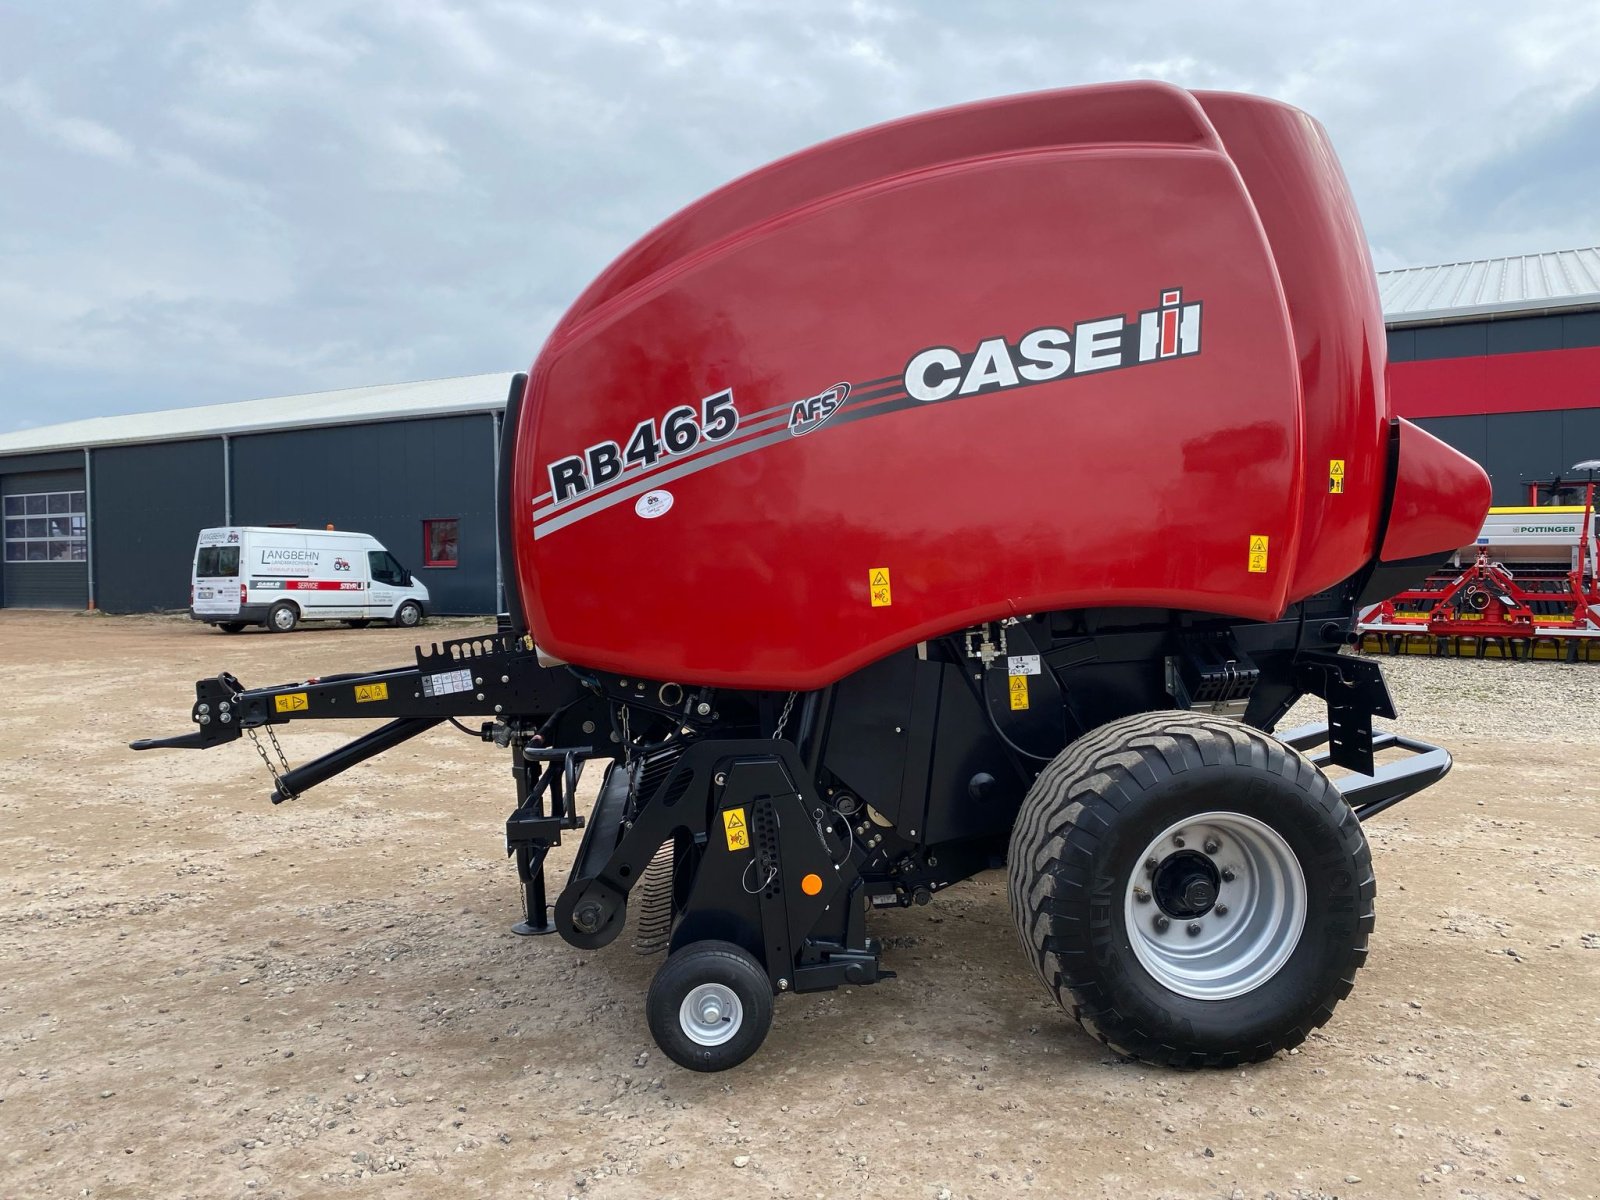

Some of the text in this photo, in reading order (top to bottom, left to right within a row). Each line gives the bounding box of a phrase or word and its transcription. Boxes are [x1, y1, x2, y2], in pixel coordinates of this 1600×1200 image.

[904, 317, 1124, 401] CASE
[787, 389, 839, 429] AFS
[546, 386, 740, 507] RB465
[261, 550, 320, 564] LANGBEHN
[297, 582, 319, 590] SERVICE
[339, 582, 358, 590] STEYR
